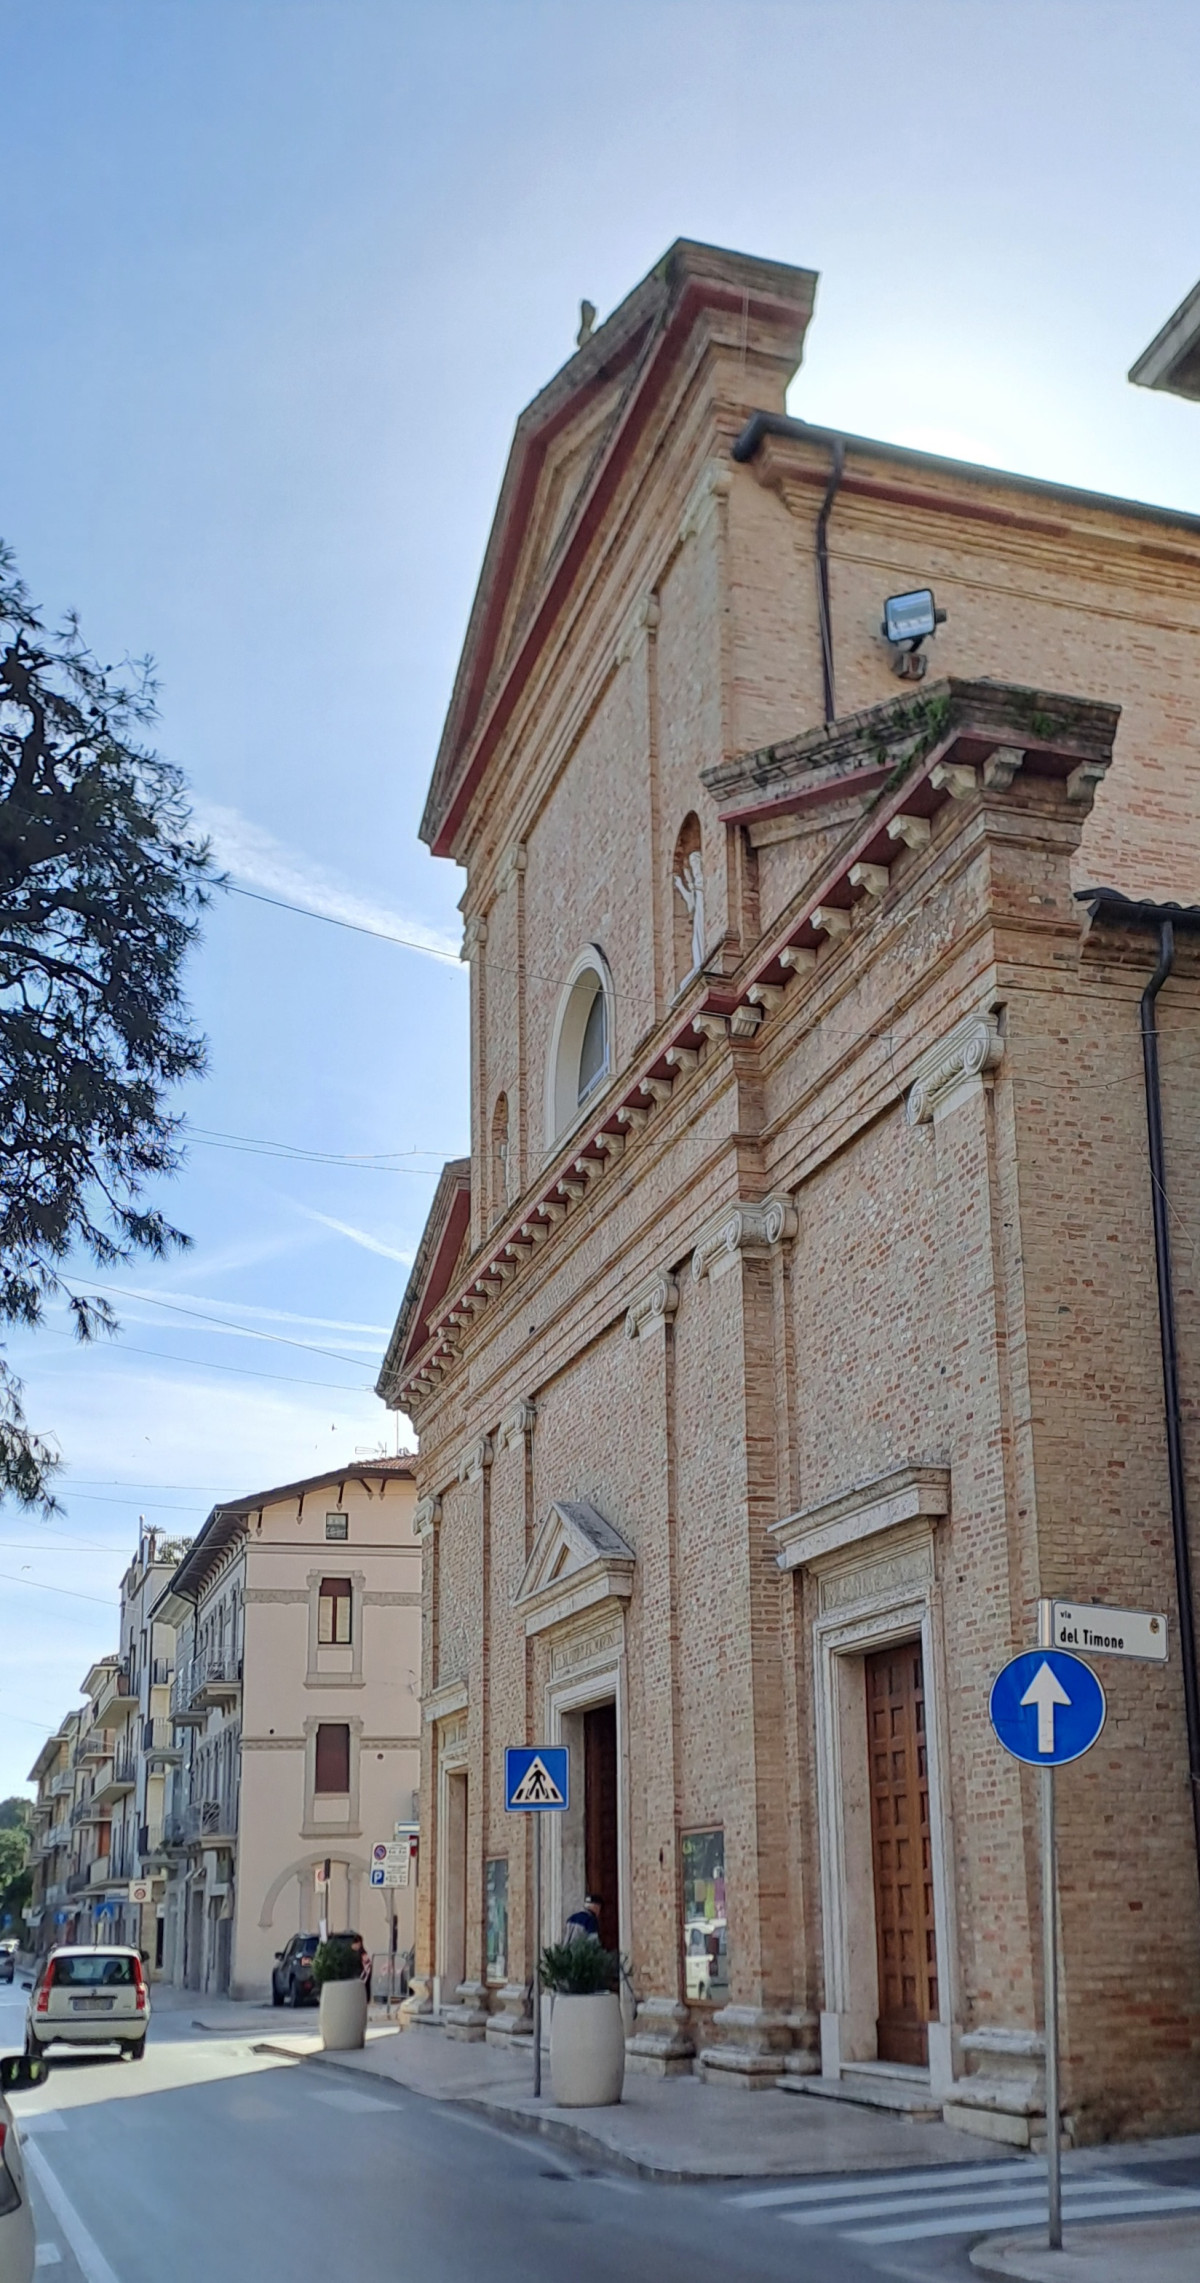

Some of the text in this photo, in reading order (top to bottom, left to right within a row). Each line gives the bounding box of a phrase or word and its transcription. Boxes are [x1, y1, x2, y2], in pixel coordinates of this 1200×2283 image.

[1060, 1610, 1071, 1619] via
[1060, 1626, 1124, 1649] del Timone
